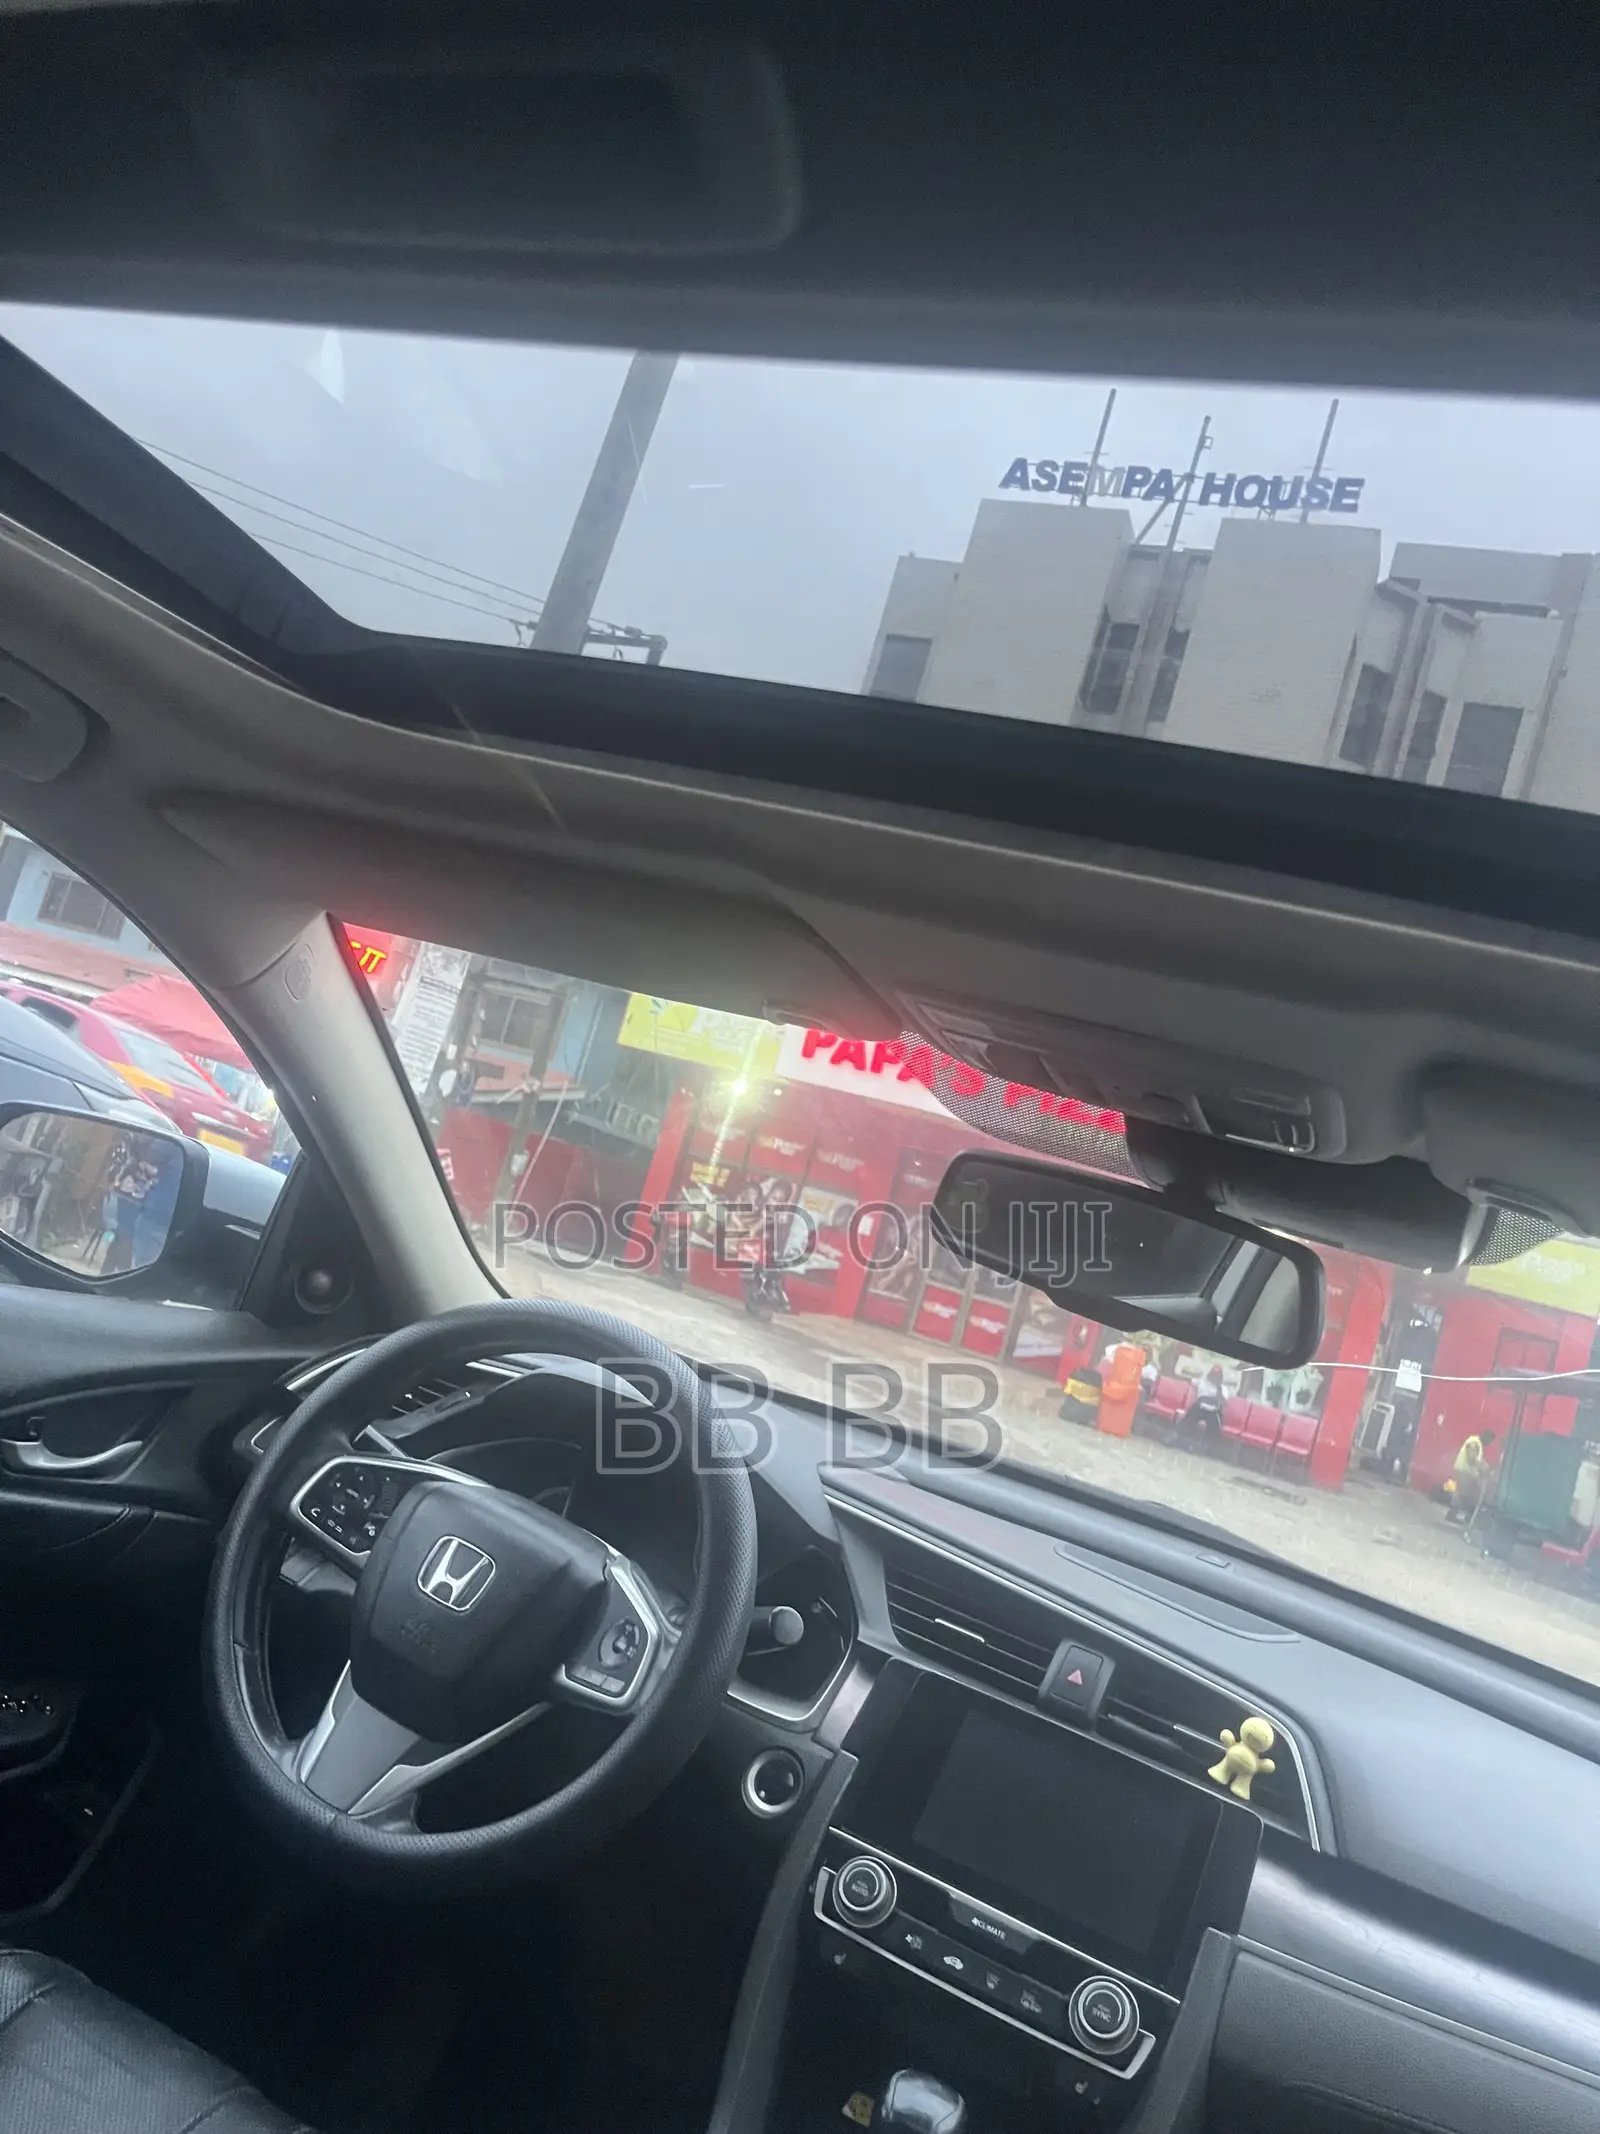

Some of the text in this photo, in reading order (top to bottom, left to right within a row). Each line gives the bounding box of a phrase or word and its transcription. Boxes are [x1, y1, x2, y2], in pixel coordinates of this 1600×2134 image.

[999, 457, 1366, 514] ASEMPA HOUSE
[801, 1028, 986, 1097] PAPA'S
